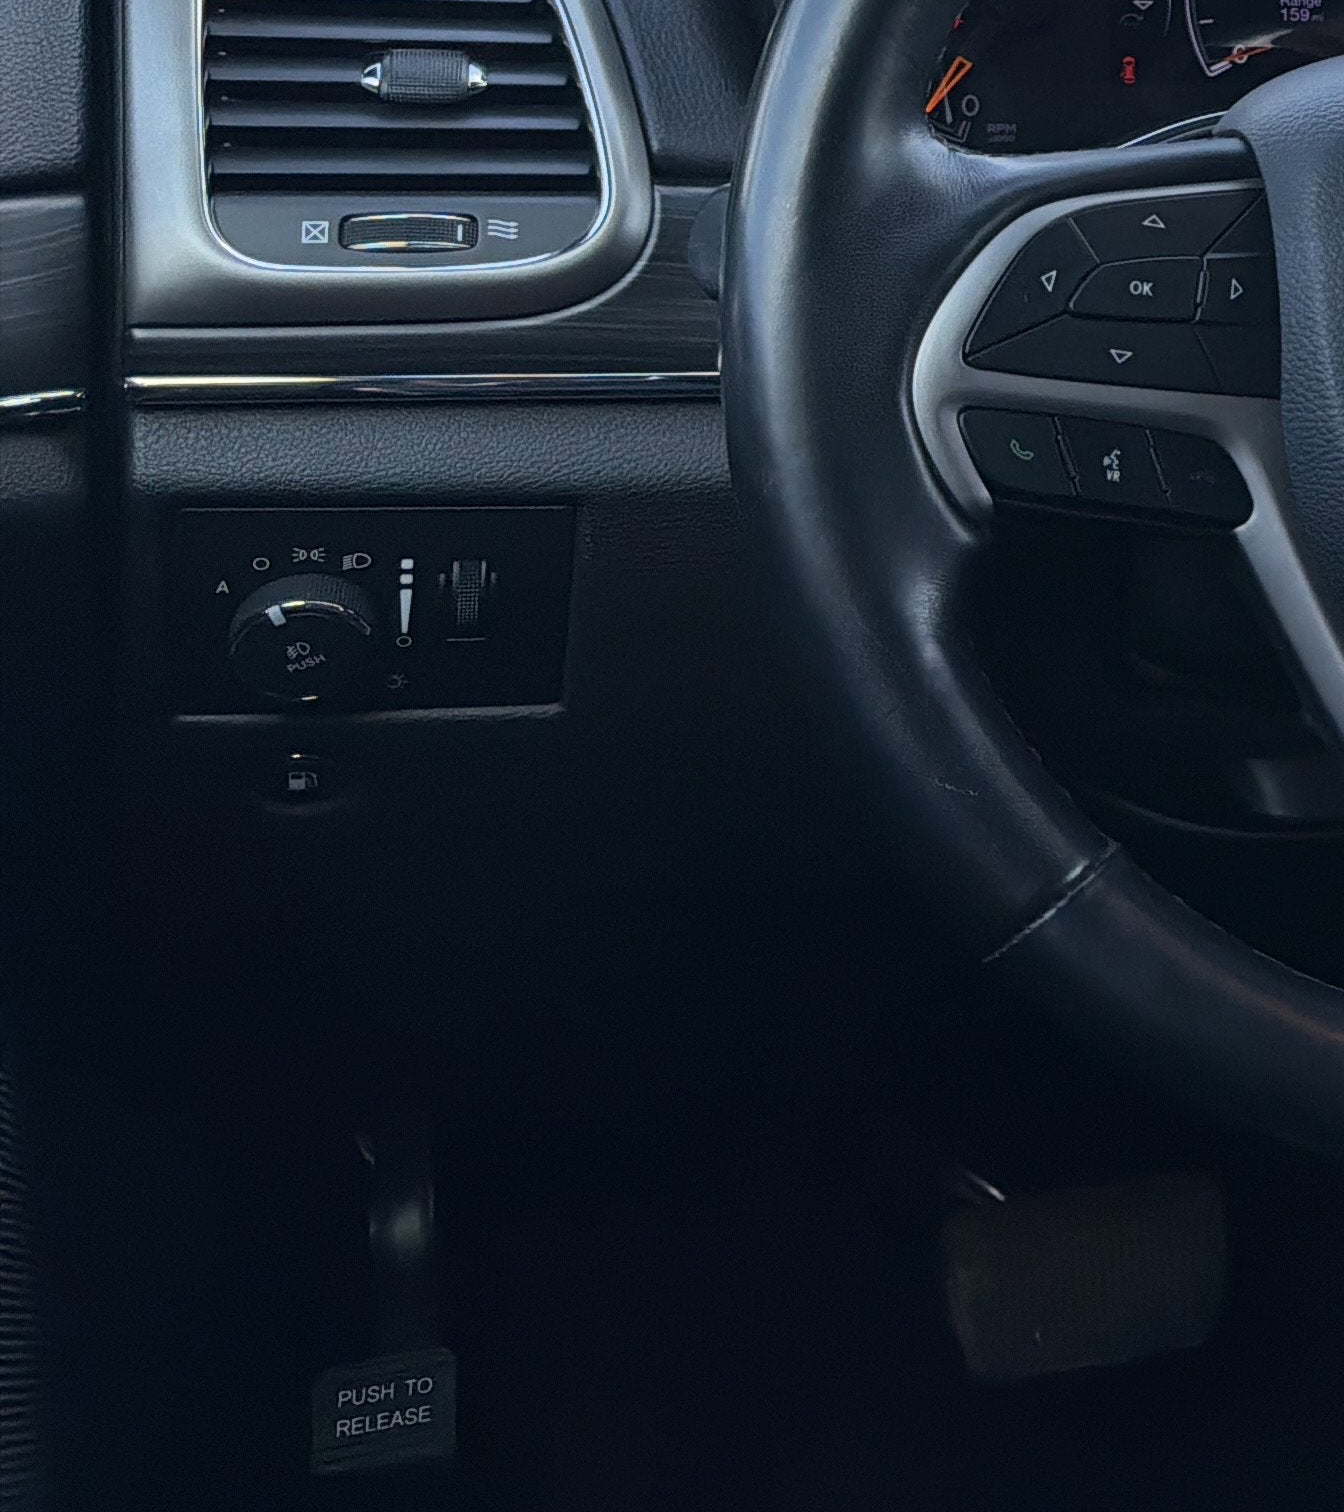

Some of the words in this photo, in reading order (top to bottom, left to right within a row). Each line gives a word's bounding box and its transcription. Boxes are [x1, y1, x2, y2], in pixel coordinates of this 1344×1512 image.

[1280, 8, 1310, 22] 159
[987, 123, 1017, 135] RPM
[1129, 280, 1153, 296] OK
[1106, 470, 1121, 483] VR
[216, 581, 229, 594] A
[286, 654, 326, 673] PUSH
[337, 1382, 395, 1408] PUSH
[404, 1377, 433, 1396] TO
[335, 1405, 432, 1437] RELEASE
